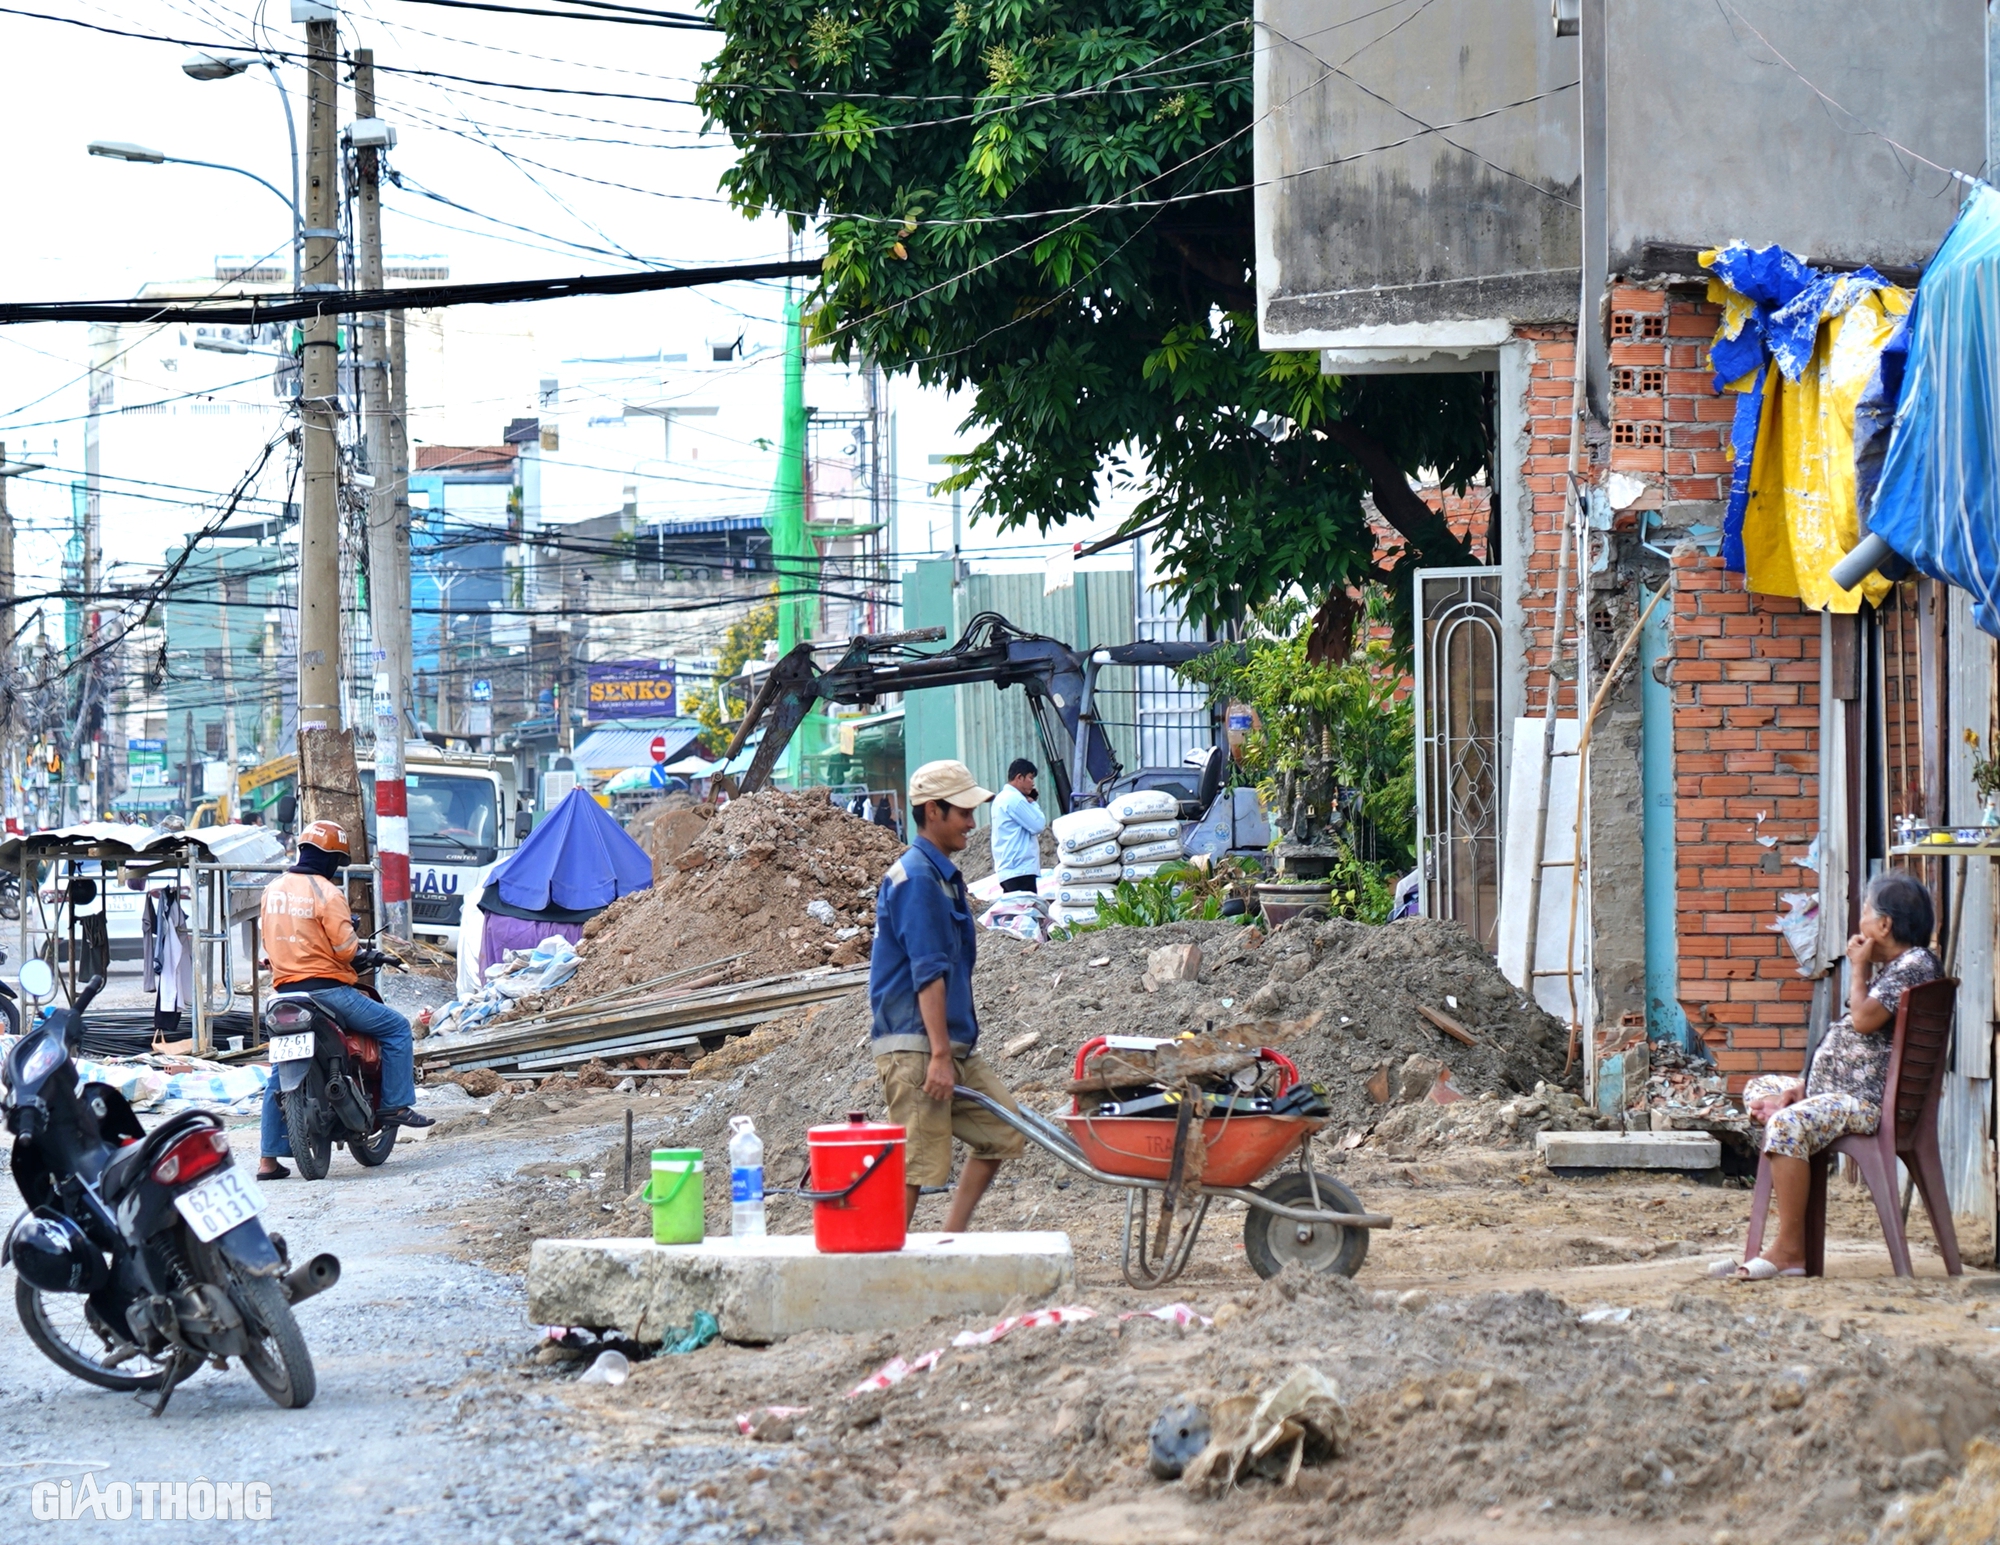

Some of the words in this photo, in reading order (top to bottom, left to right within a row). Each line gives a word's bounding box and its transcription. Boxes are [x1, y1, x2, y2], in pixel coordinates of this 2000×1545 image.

[590, 680, 673, 702] SENKO
[277, 1034, 307, 1048] 72-G1
[188, 1174, 243, 1213] 62-T2
[202, 1192, 257, 1233] 0131
